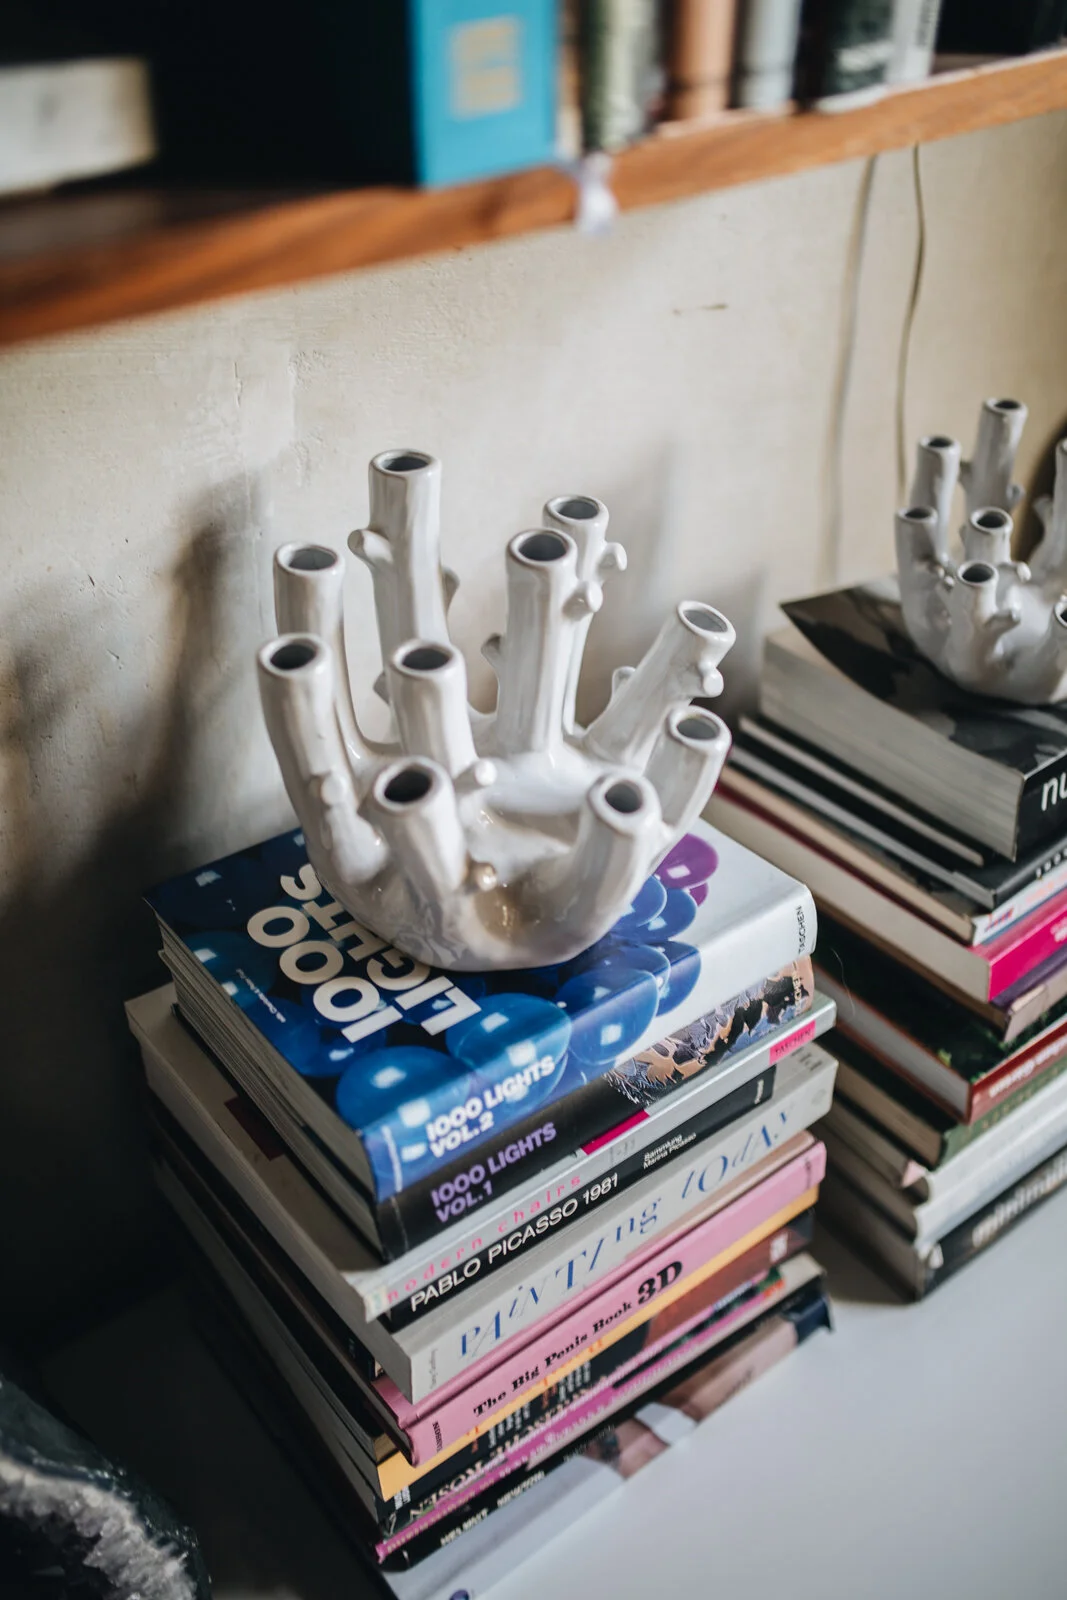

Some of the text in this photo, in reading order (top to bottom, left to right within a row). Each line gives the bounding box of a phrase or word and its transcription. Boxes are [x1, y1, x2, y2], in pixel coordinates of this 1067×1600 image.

[796, 904, 806, 955] TASCHEN
[247, 906, 403, 1043] 1000
[425, 1056, 556, 1143] 1000 LIGHTS
[478, 1111, 494, 1132] 2
[431, 1162, 486, 1208] 1000
[488, 1121, 557, 1177] LIGHTS
[480, 1181, 494, 1199] 1
[497, 1174, 582, 1234] chairs
[410, 1173, 618, 1312] PABLO PICASSO 1981
[473, 1260, 682, 1418] The Big Penis Book 3D
